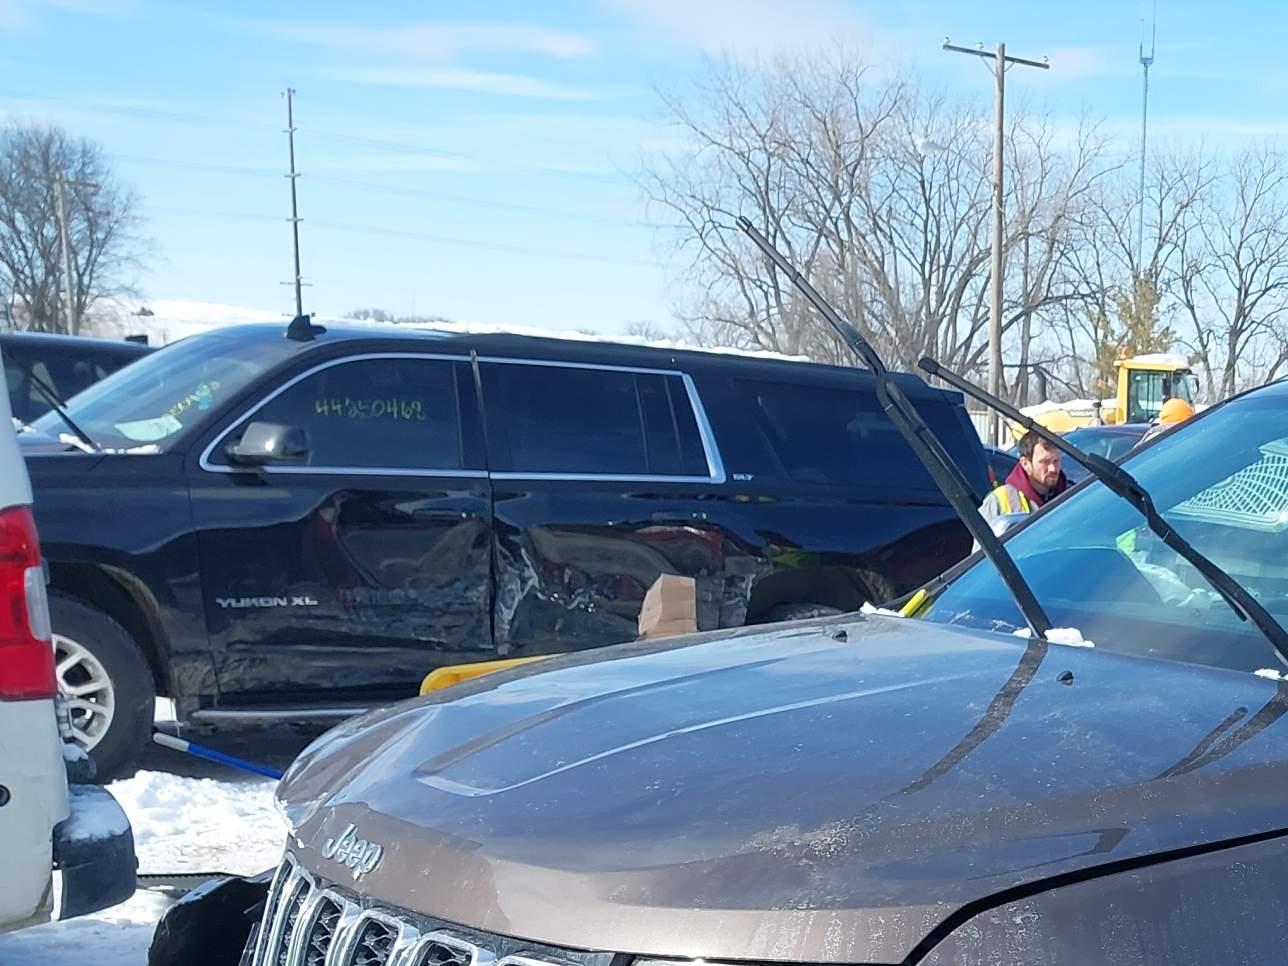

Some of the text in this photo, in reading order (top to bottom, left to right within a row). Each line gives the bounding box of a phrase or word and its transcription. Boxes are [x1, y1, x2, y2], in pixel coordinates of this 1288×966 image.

[216, 596, 319, 609] YUKON XL
[321, 823, 384, 882] Jeep
